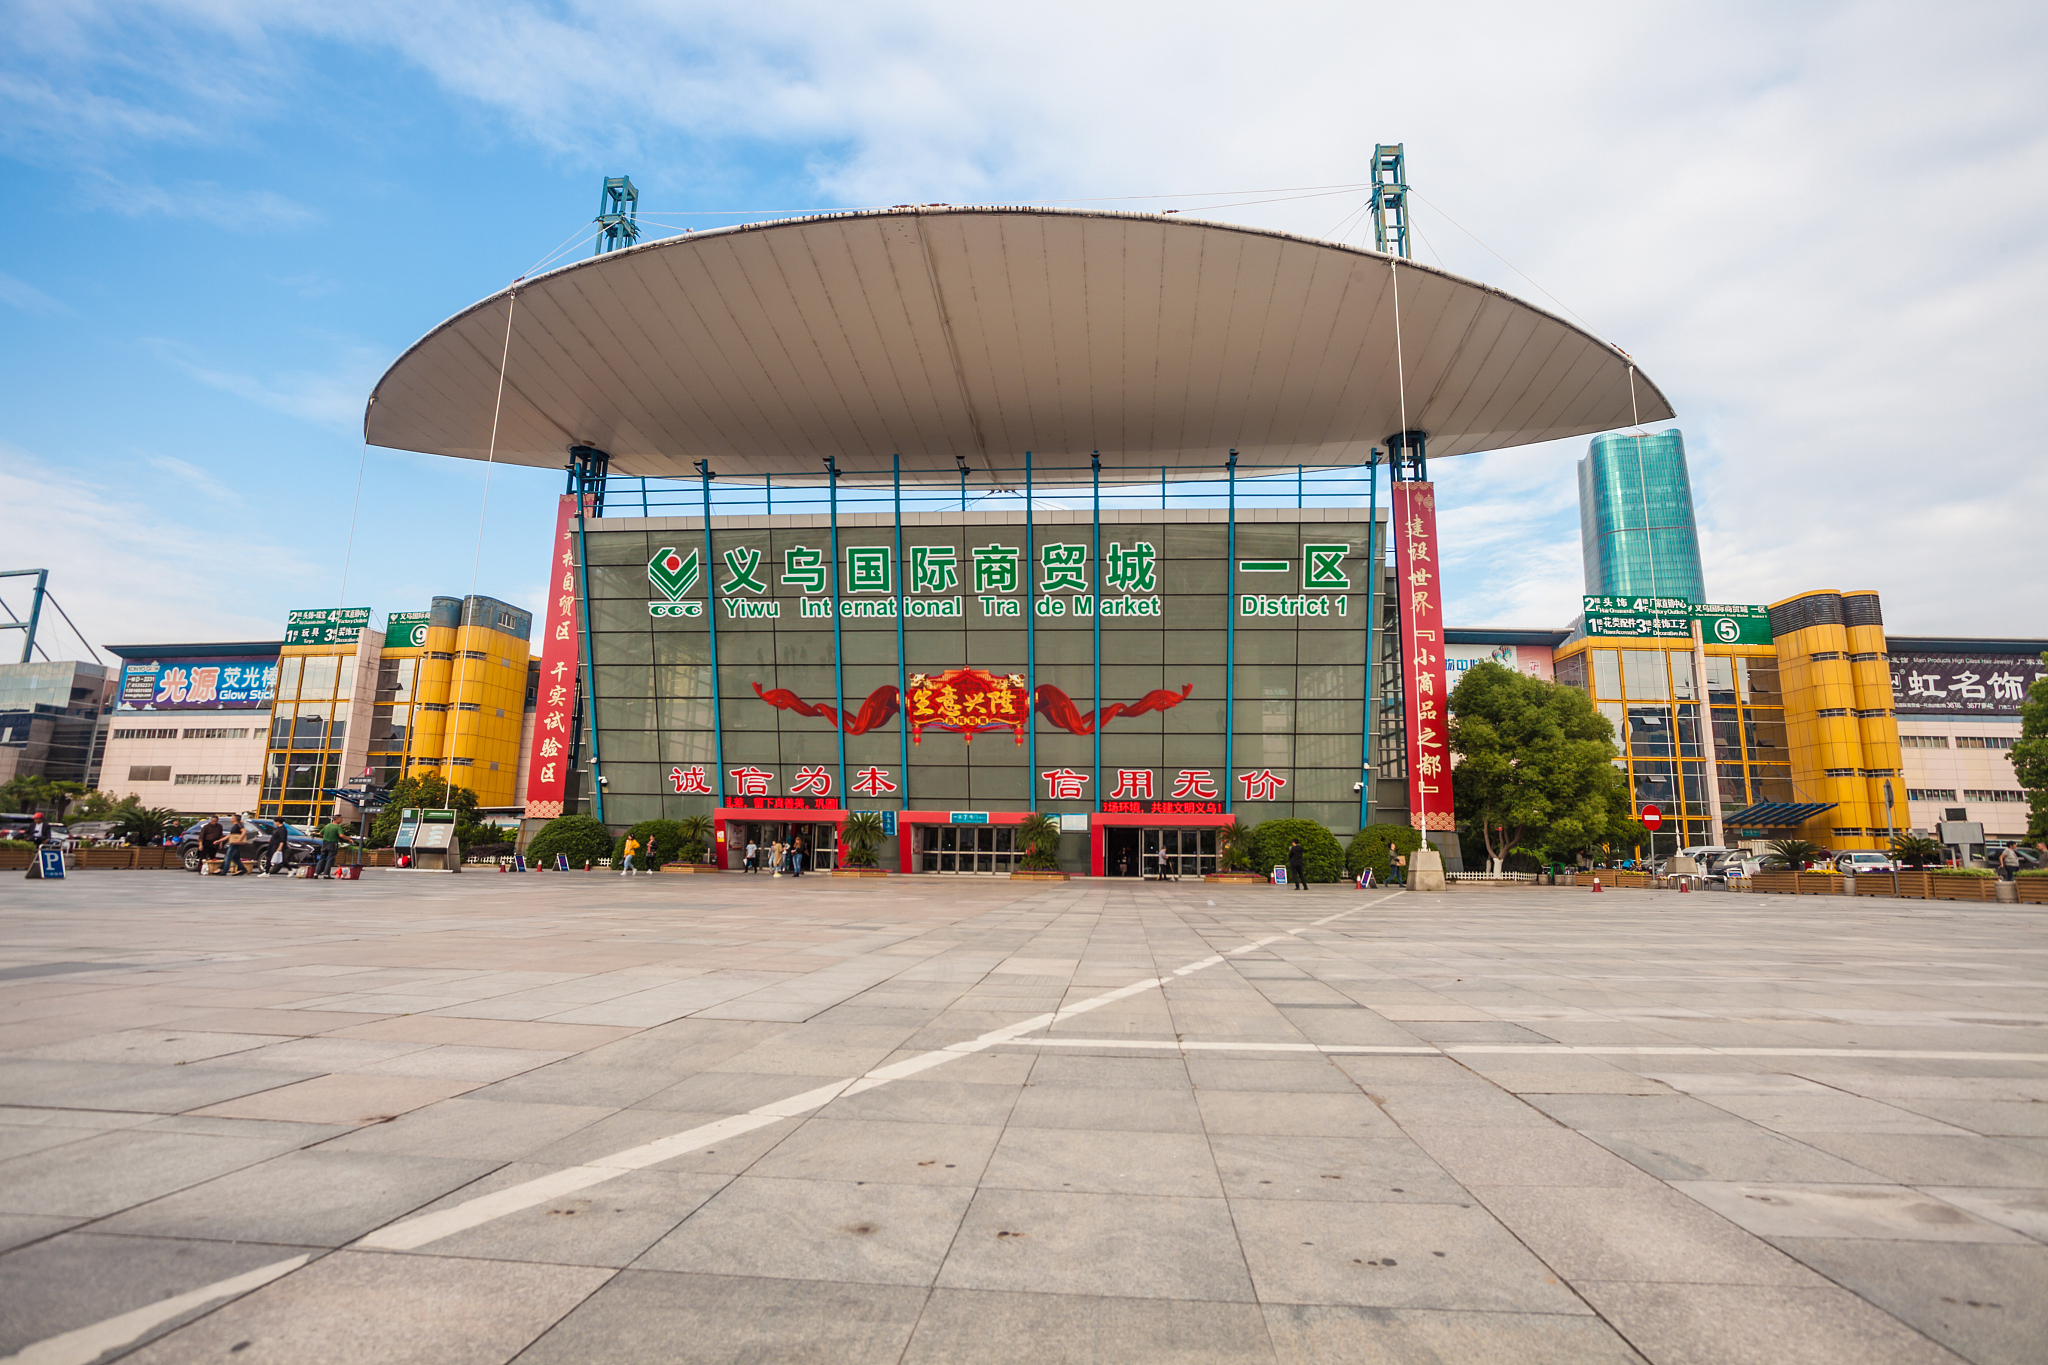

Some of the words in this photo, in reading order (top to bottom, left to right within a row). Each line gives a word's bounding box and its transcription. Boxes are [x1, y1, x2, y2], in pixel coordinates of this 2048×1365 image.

[720, 542, 1156, 595] 义乌国际商贸城
[1239, 543, 1350, 590] 一区
[722, 597, 780, 618] Yiwu
[800, 596, 963, 618] International
[979, 595, 1065, 616] Trade
[1072, 594, 1161, 616] Market
[1240, 594, 1329, 616] District
[1335, 594, 1347, 616] 1
[1603, 597, 1628, 607] 头饰
[156, 666, 220, 703] 光源
[219, 689, 247, 700] Glow
[913, 684, 1017, 716] 生意兴隆
[1908, 670, 2048, 701] 虹名饰
[668, 765, 898, 797] 诚信为本
[1041, 767, 1287, 801] 信用无价
[44, 852, 60, 871] P
